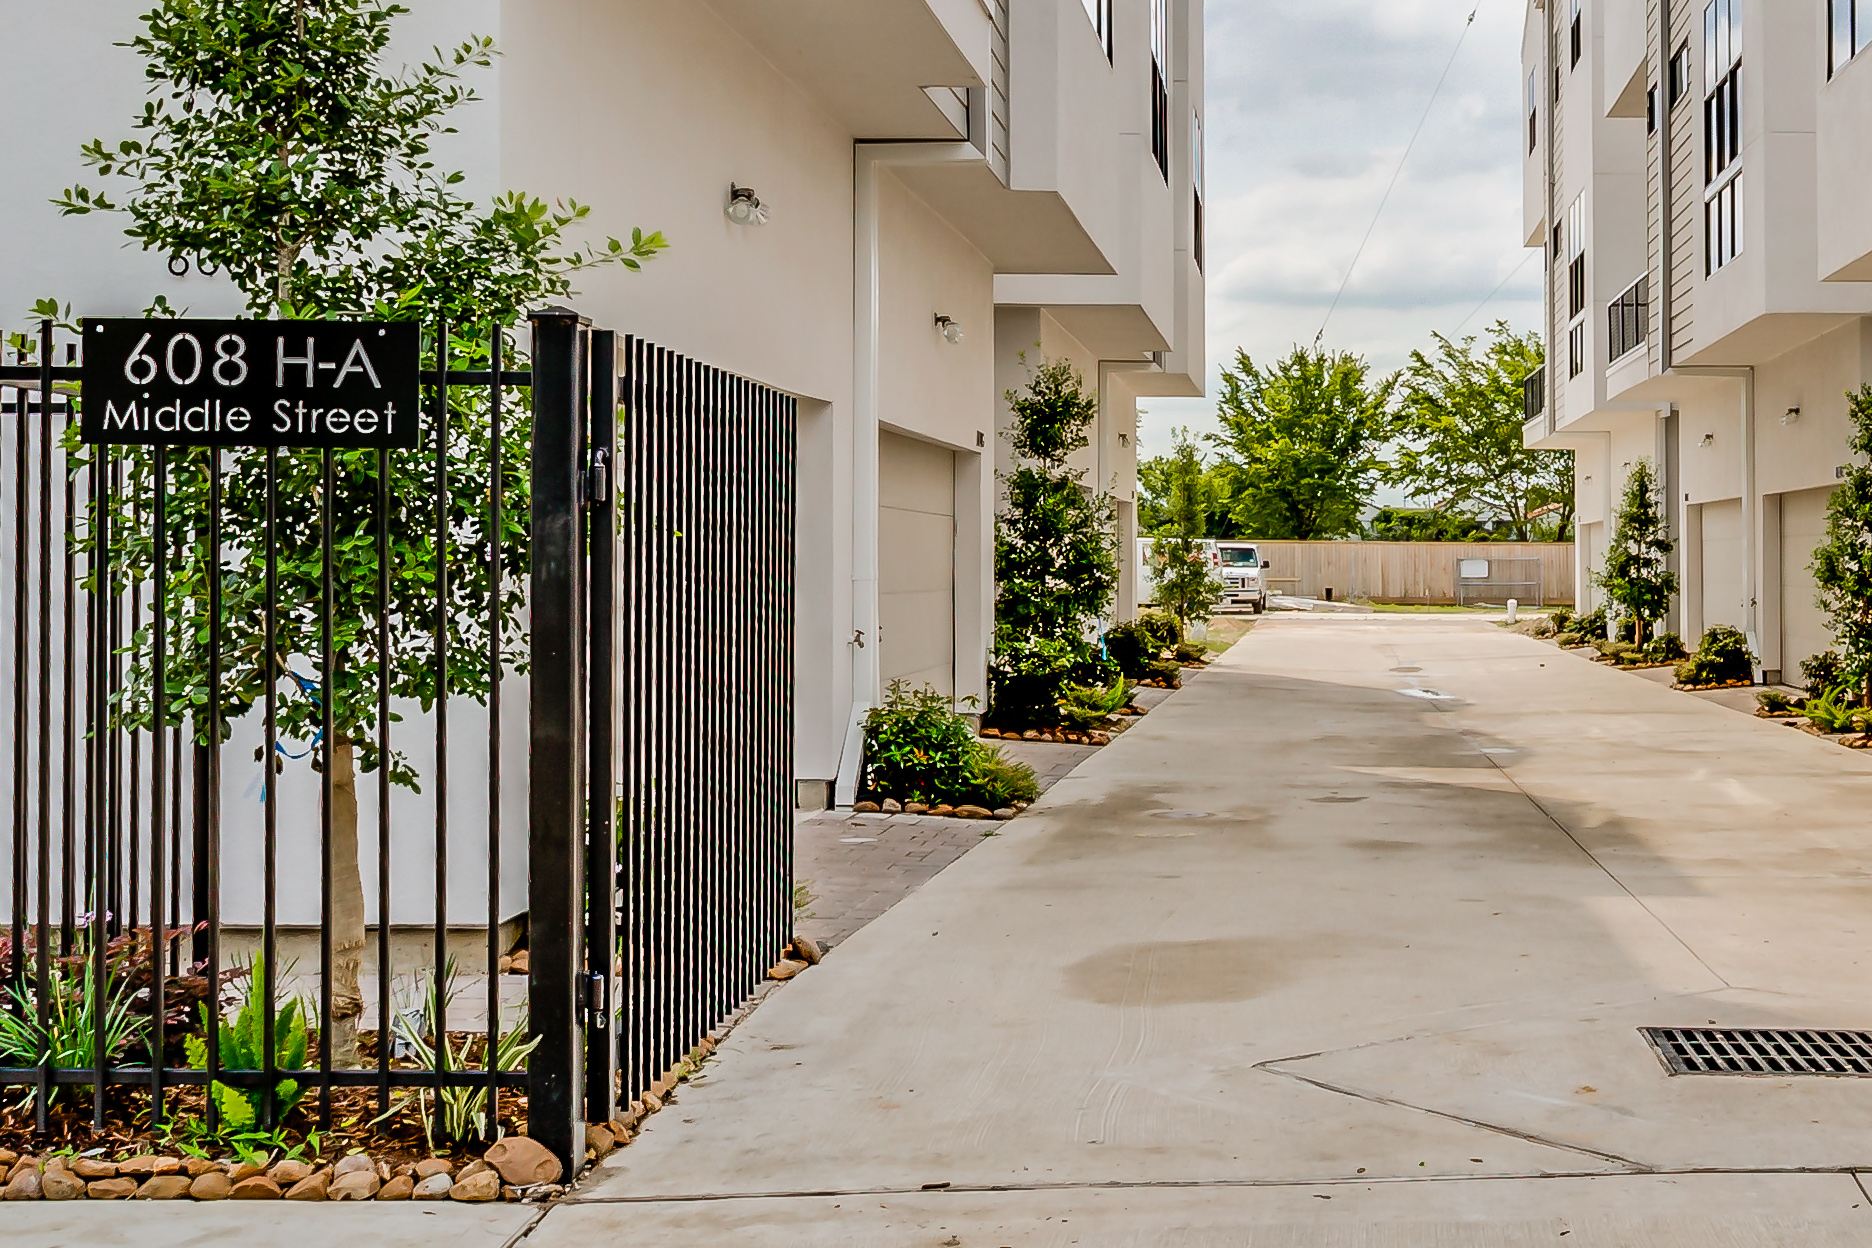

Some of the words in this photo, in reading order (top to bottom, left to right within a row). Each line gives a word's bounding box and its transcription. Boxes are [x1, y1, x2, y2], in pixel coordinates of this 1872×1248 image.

[124, 332, 248, 386] 608
[276, 336, 382, 389] H-A
[102, 392, 252, 432] Middle
[272, 398, 397, 435] Street
